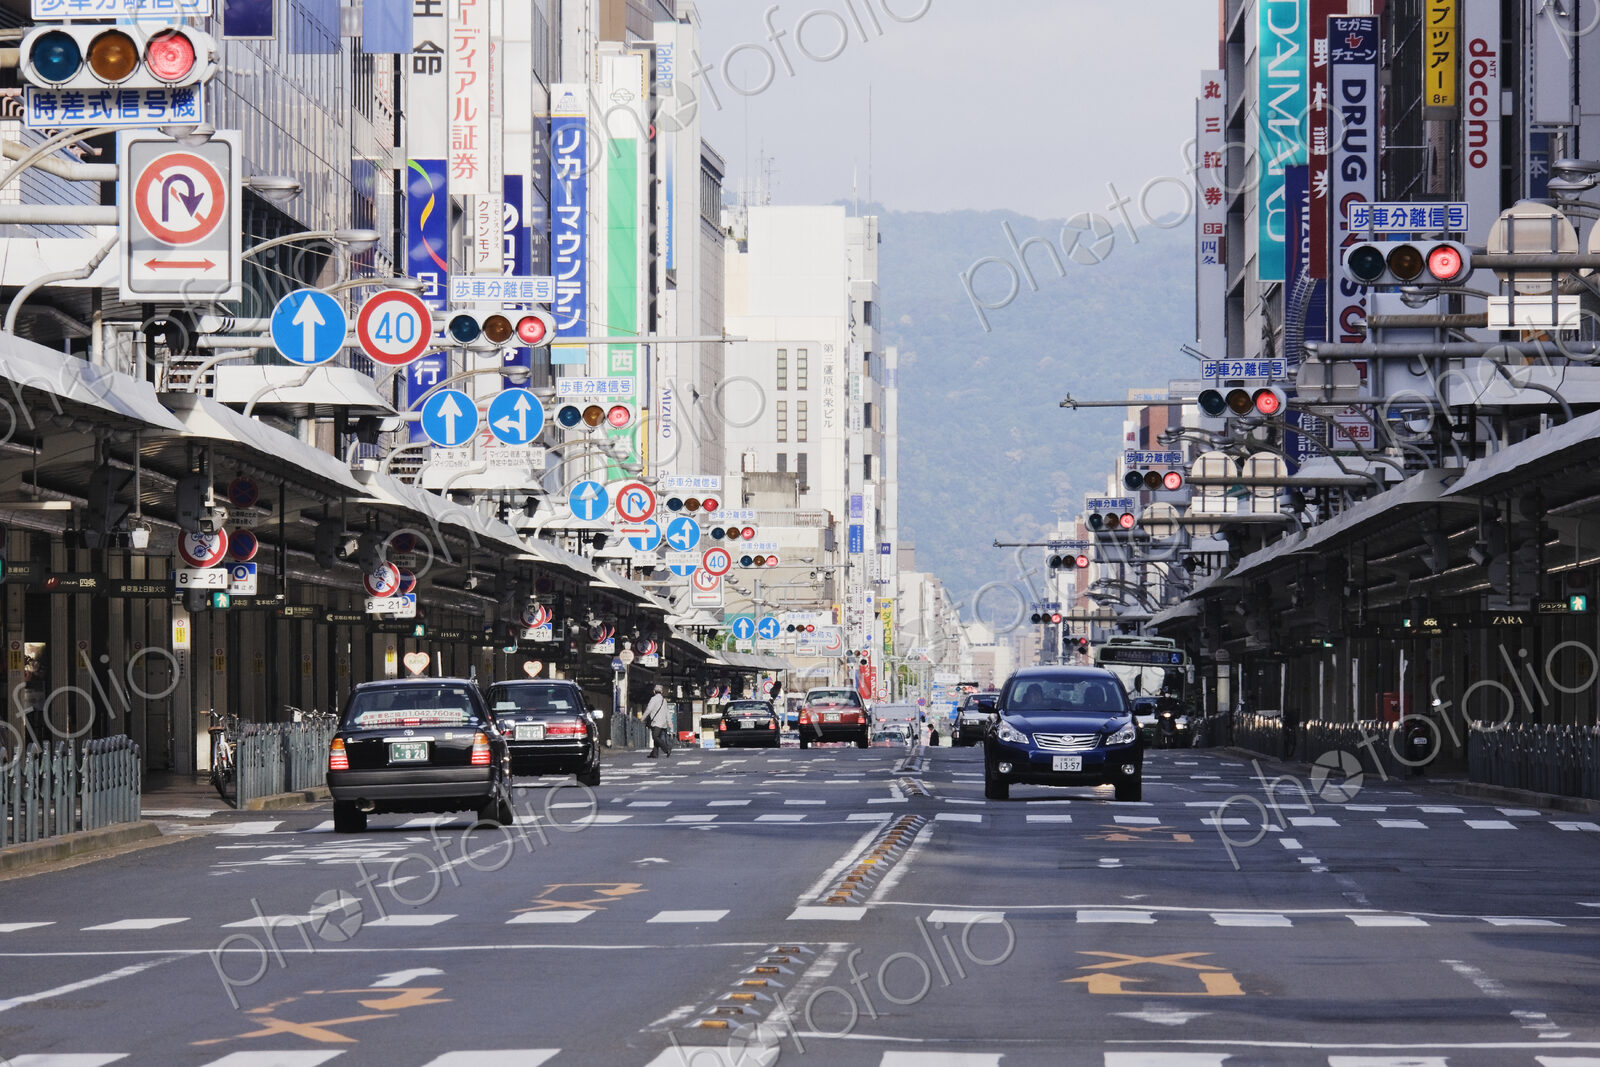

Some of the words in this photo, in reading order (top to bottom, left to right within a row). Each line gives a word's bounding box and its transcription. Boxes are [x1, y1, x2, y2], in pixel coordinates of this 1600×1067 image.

[1336, 19, 1372, 31] セガミ
[1331, 49, 1376, 61] チェーン
[452, 0, 480, 179] ーディアル証券
[33, 91, 195, 120] 時差式信号機
[1433, 94, 1448, 104] 8F
[1469, 38, 1496, 169] docomo
[1341, 79, 1367, 182] DRUG
[1204, 81, 1222, 205] 丸三証券
[1354, 208, 1464, 228] 歩車分離信号
[557, 130, 581, 330] リカーマウンテン
[1204, 223, 1221, 234] 9F
[455, 281, 550, 299] 歩車分離信号
[375, 311, 415, 344] 40
[1205, 362, 1283, 377] 歩車分離信号
[561, 380, 631, 394] 歩車分離信号
[663, 387, 671, 439] MIZUHO
[1127, 452, 1181, 463] 歩車分離信号
[668, 478, 719, 488] 歩車分離信号
[1088, 499, 1134, 508] 歩車分離信号
[712, 511, 754, 519] 歩車分離信号
[709, 555, 725, 568] 40
[121, 585, 166, 593] 東京海上日動火災
[1492, 616, 1523, 625] ZARA
[414, 750, 426, 759] 28
[1060, 762, 1080, 770] 13-57
